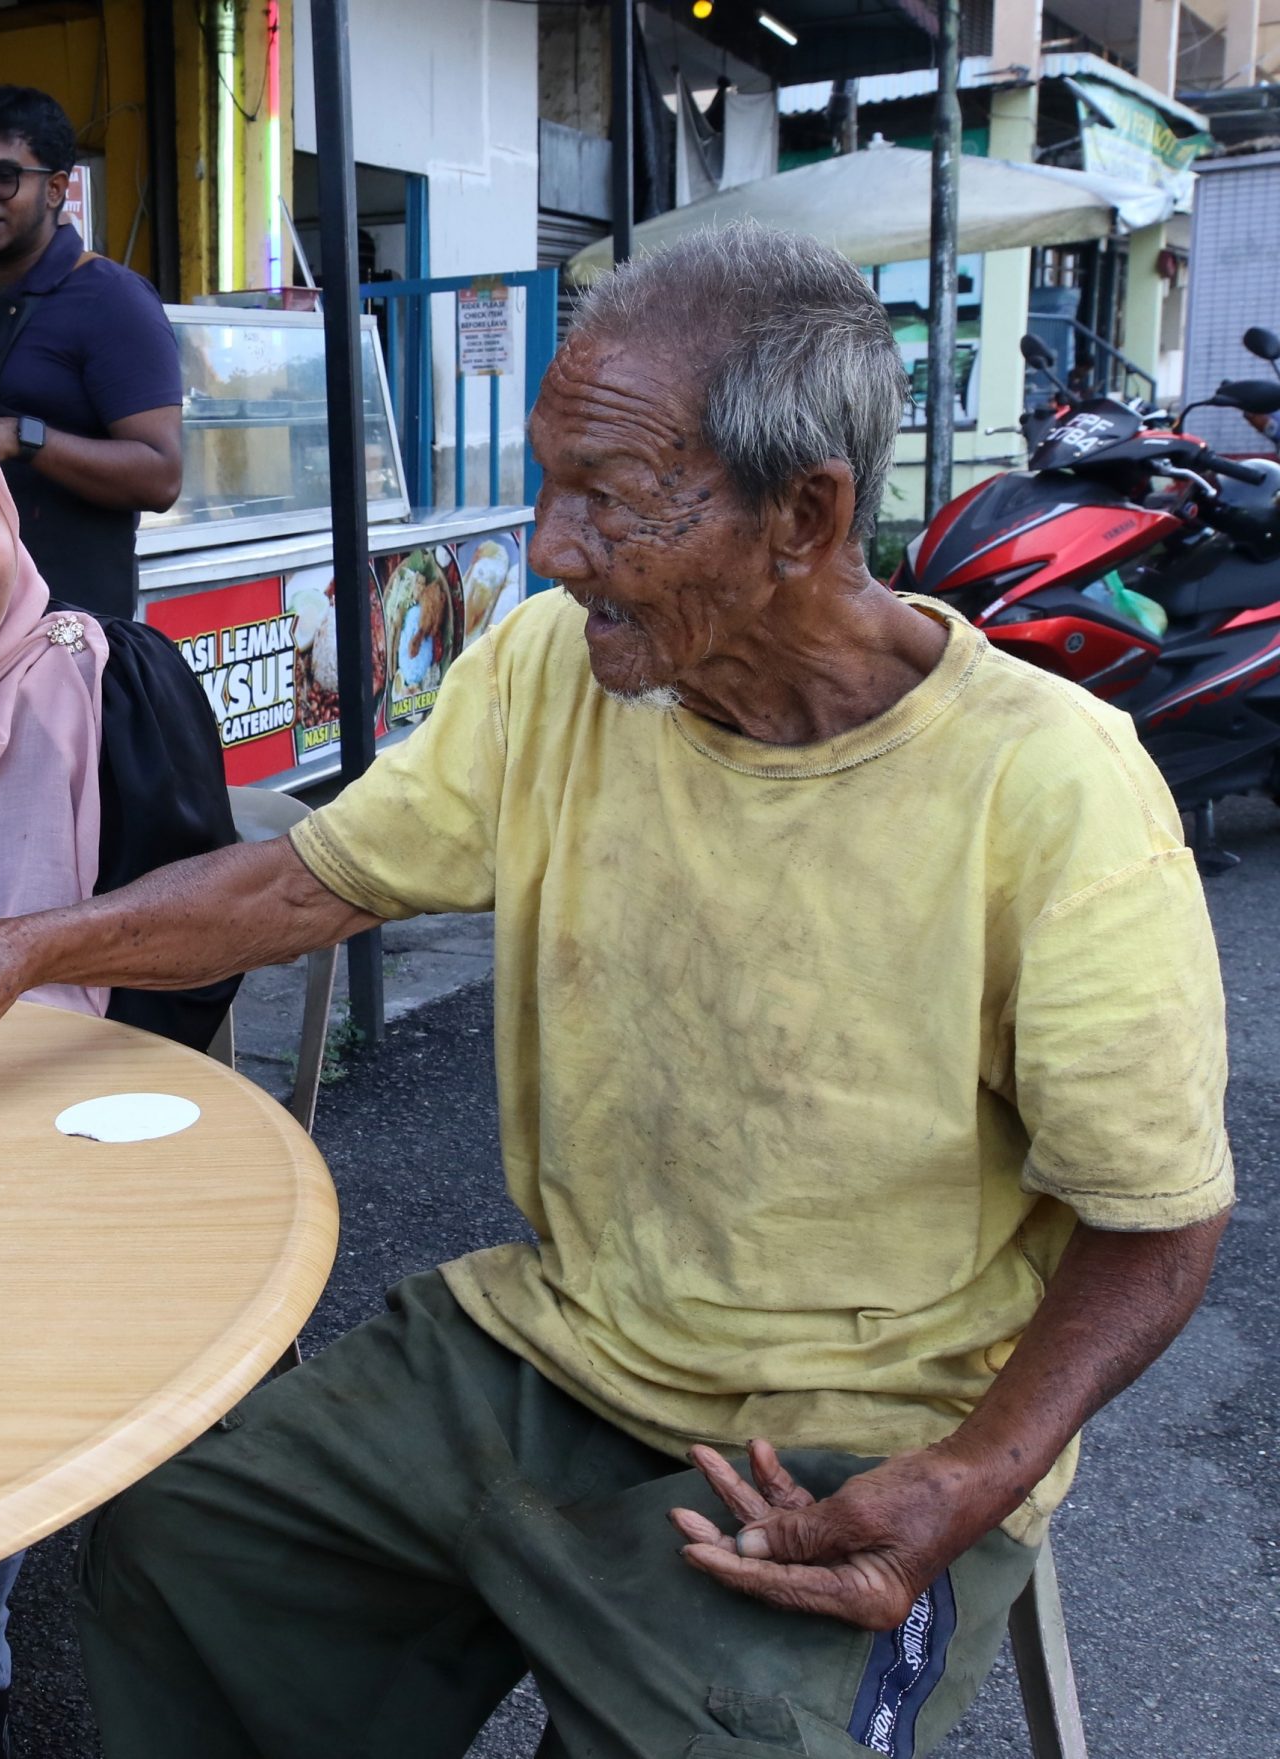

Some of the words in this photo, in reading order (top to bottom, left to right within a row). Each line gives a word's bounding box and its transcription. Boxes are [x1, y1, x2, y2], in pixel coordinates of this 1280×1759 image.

[464, 311, 487, 320] CHECK
[482, 301, 505, 309] PLEASE
[461, 321, 486, 329] BEFORE
[487, 320, 508, 328] LEAVE
[180, 634, 215, 673] ASI
[222, 616, 294, 665] LEMAK
[201, 650, 294, 723] KSUE
[391, 697, 412, 718] NASI
[221, 700, 294, 744] CATERING
[305, 725, 328, 748] NASI
